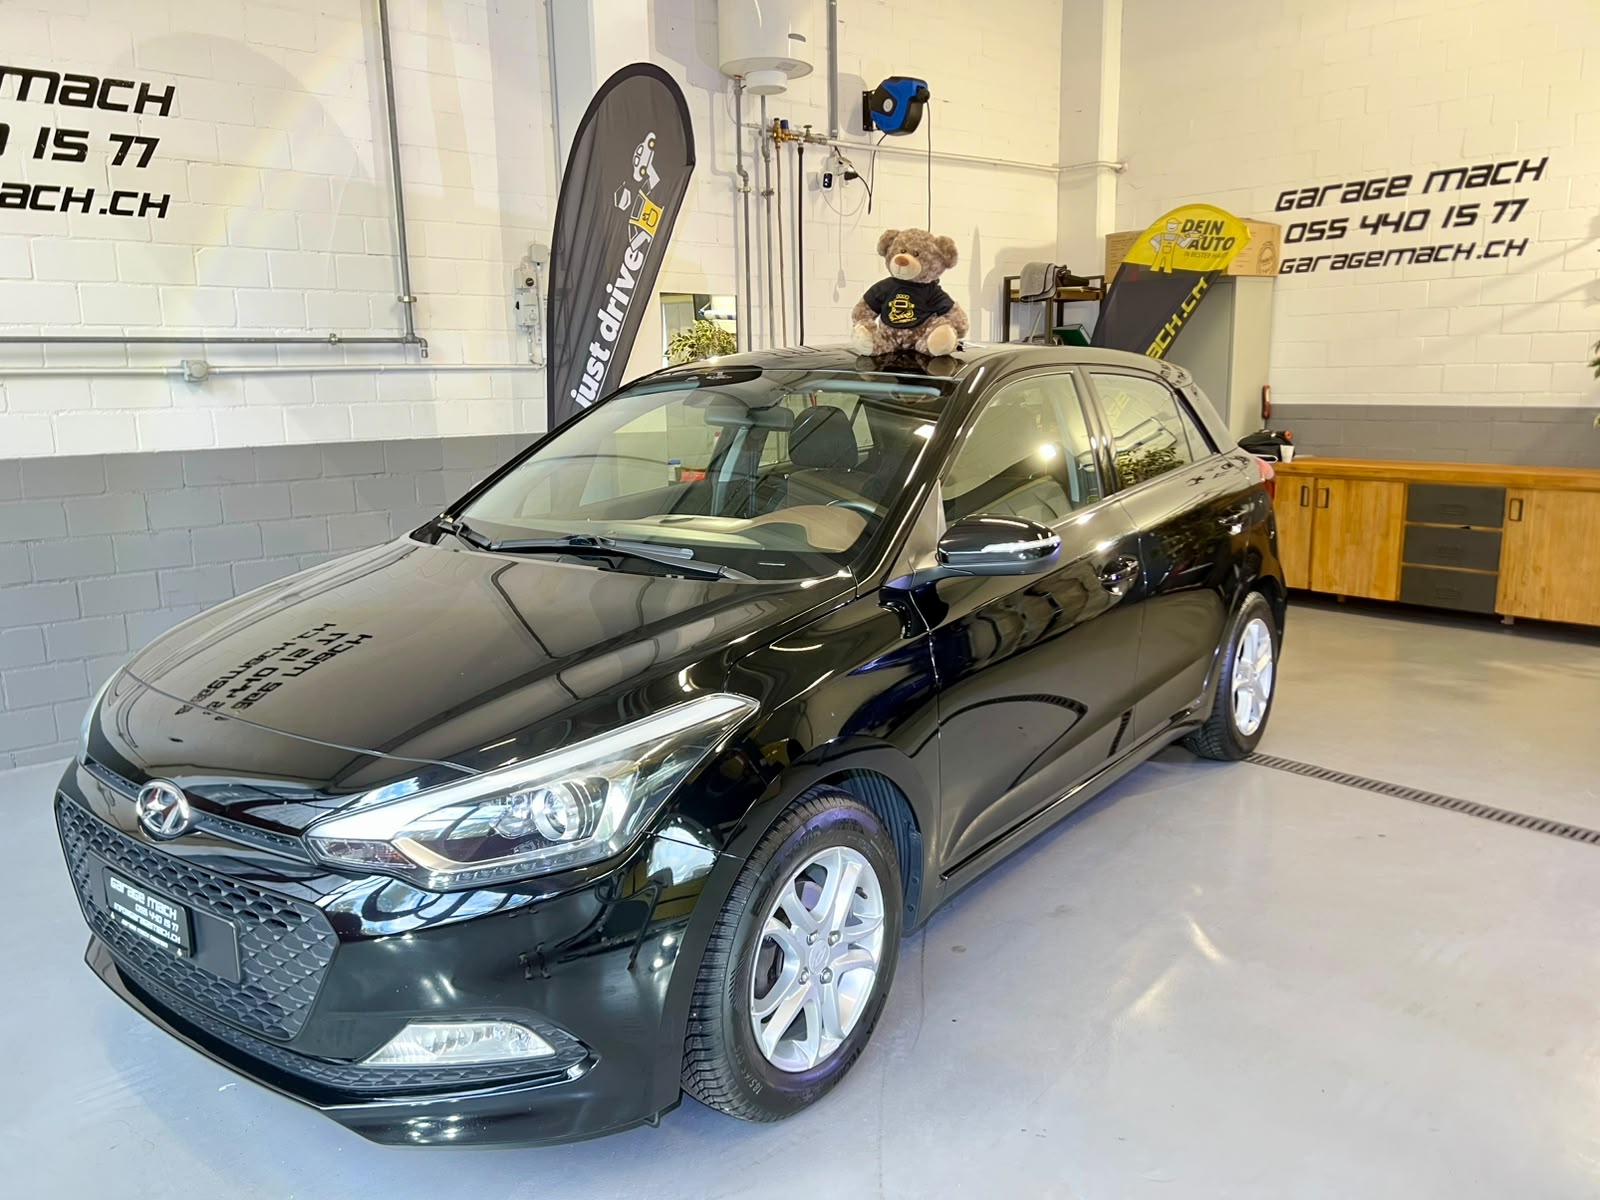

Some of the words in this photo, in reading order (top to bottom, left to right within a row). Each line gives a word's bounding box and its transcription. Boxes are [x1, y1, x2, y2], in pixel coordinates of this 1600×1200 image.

[33, 126, 90, 163] 15
[109, 133, 160, 168] 77
[1180, 218, 1225, 236] DEIN
[1284, 217, 1349, 244] 055
[1360, 208, 1431, 236] 440
[1441, 203, 1480, 229] 15
[1491, 198, 1529, 224] 77
[1188, 236, 1236, 252] AUTO
